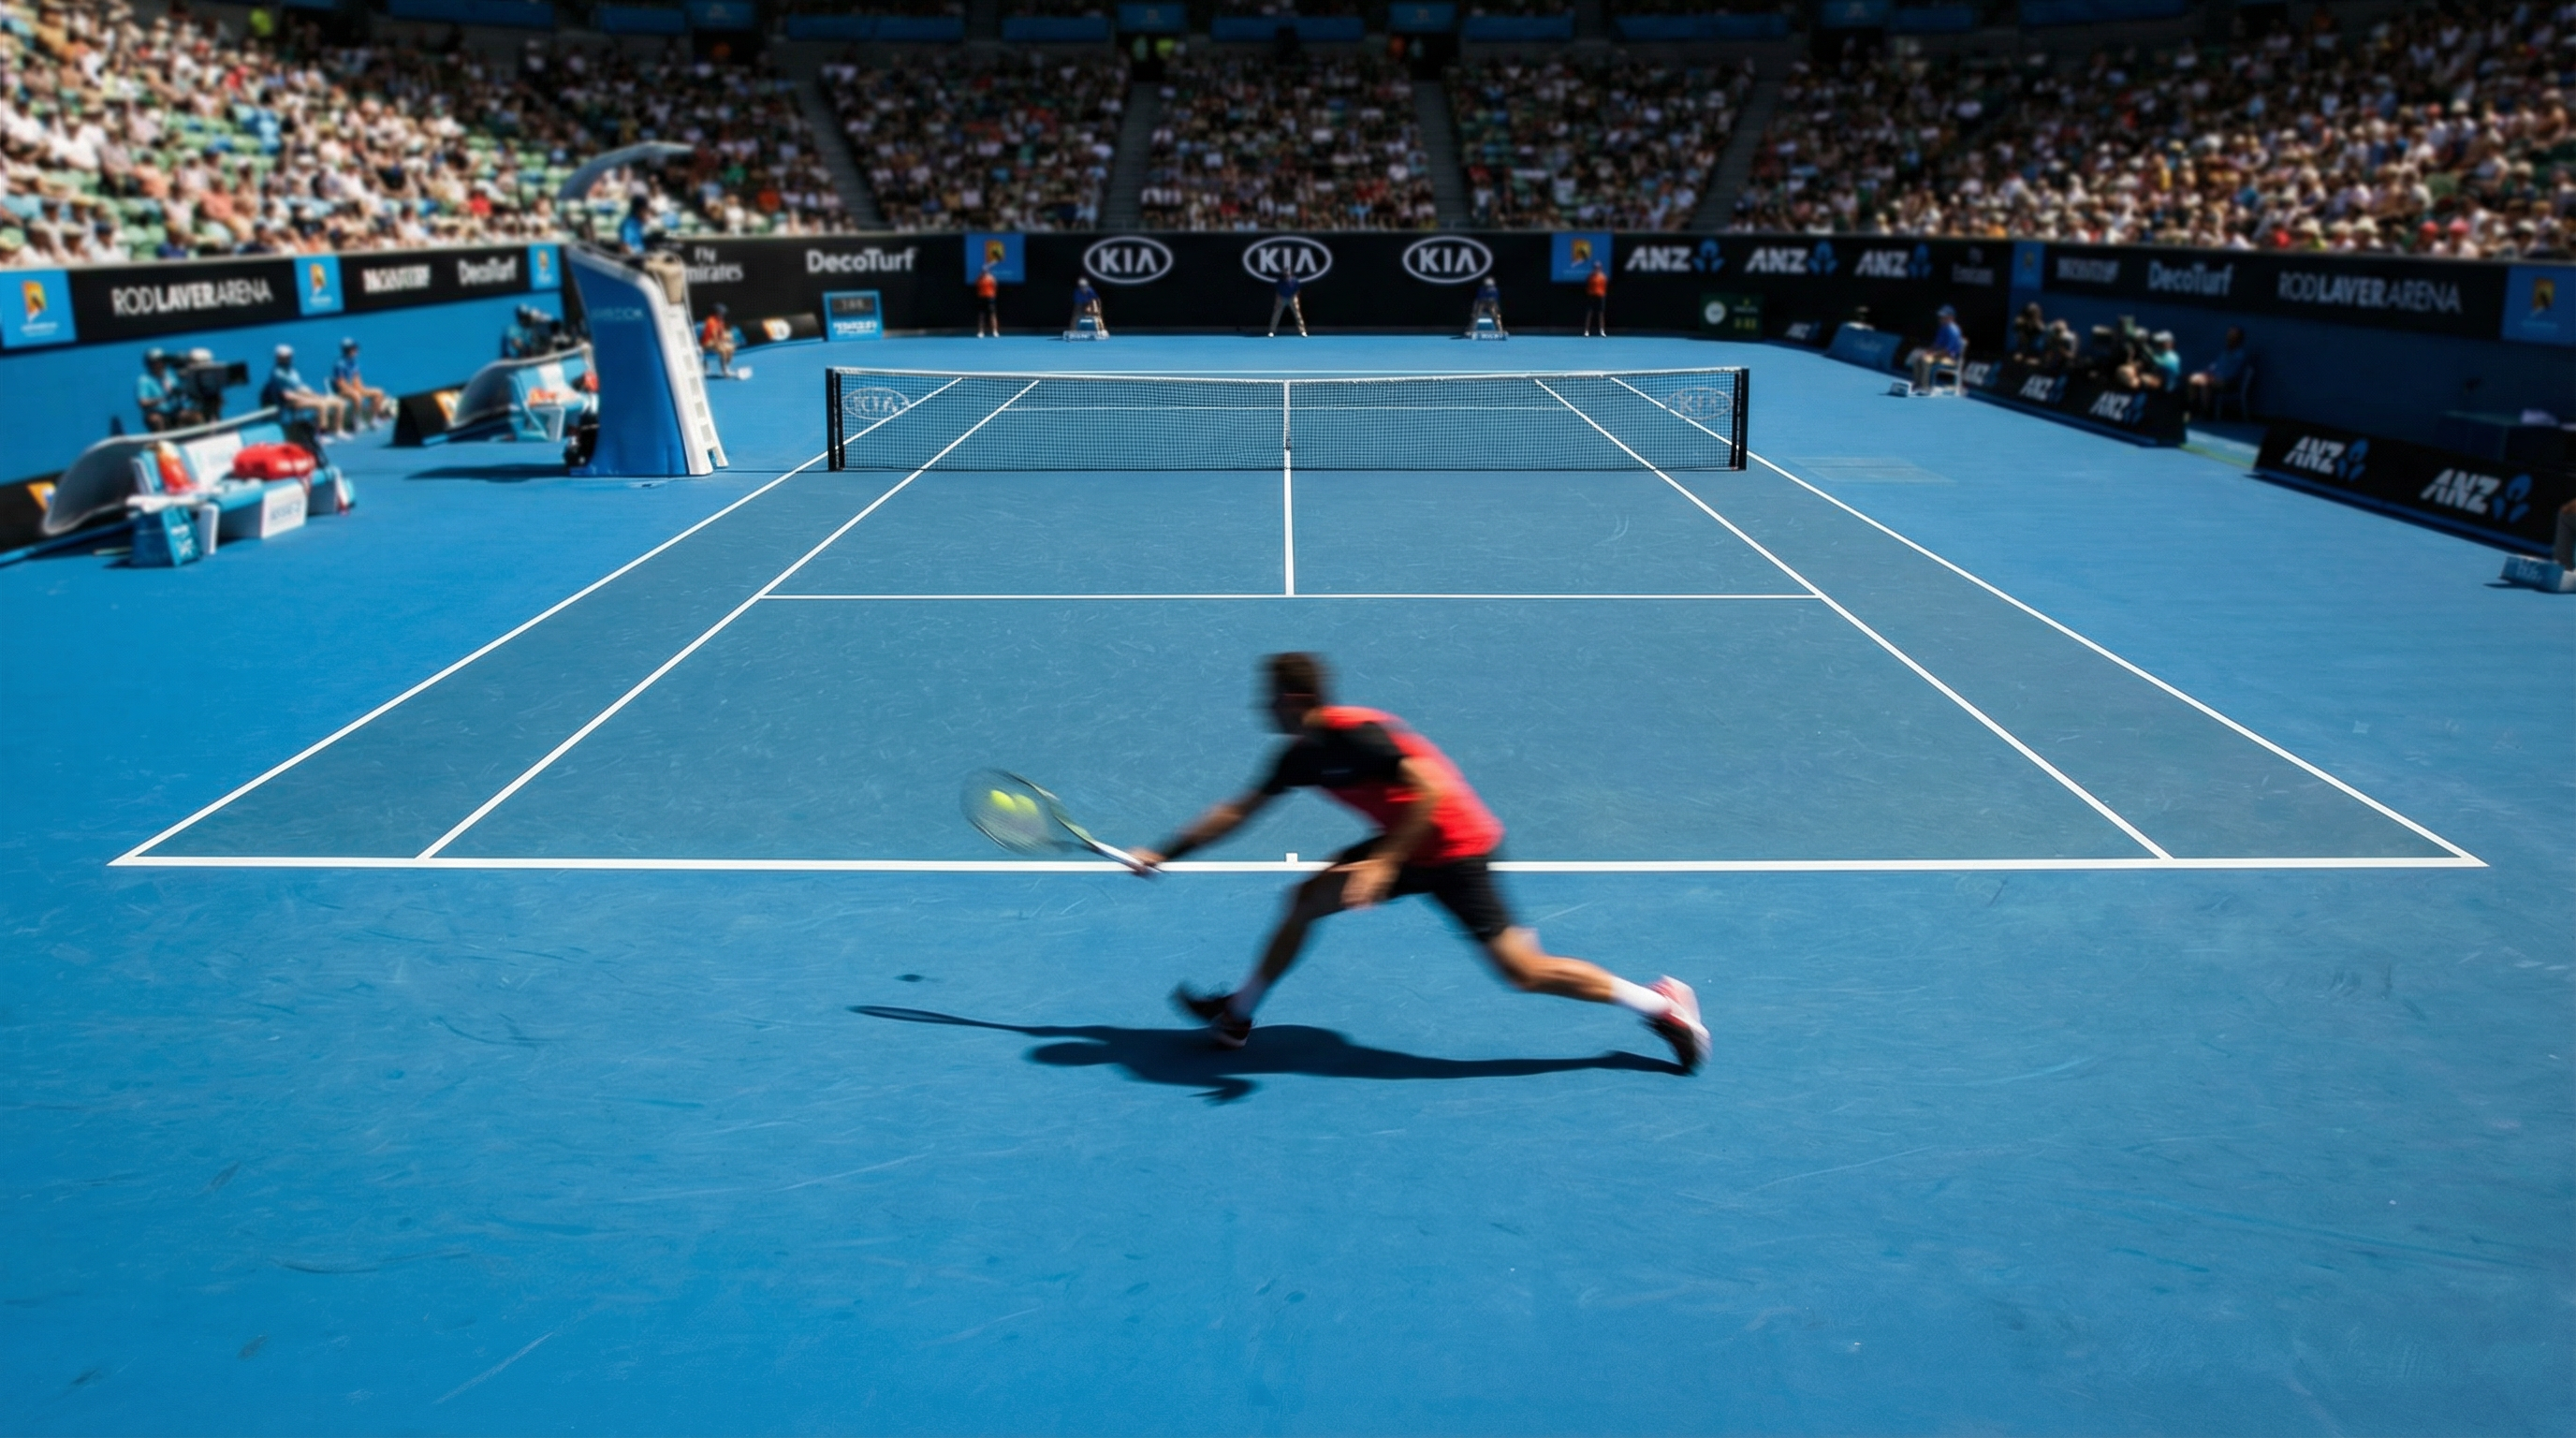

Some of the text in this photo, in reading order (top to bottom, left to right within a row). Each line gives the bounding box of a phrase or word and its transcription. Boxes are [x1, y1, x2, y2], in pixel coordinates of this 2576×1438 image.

[806, 247, 915, 273] DecoTurf
[1099, 247, 1158, 273] KIA
[1258, 247, 1318, 273] KIA
[1418, 247, 1478, 273] KIA
[1625, 246, 1691, 271] ANZ
[1745, 247, 1808, 273] ANZ
[1855, 250, 1908, 278] ANZ
[686, 262, 743, 283] mirates
[2148, 259, 2233, 296] DecoTurf
[2090, 391, 2132, 421] ANZ
[2284, 436, 2346, 474] ANZ
[2421, 468, 2501, 514] ANZ
